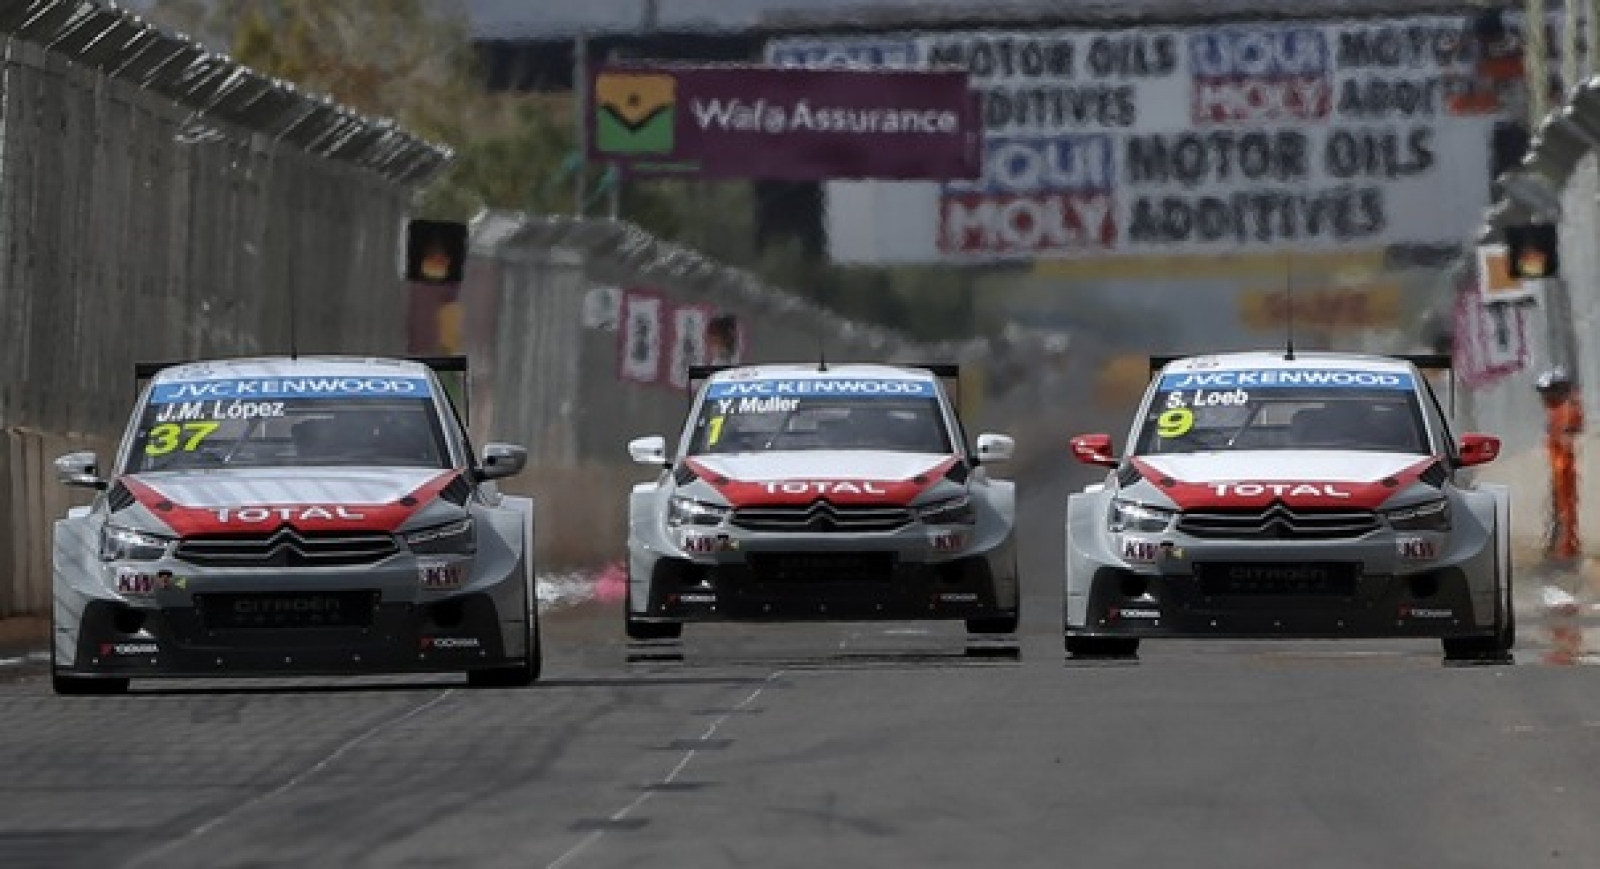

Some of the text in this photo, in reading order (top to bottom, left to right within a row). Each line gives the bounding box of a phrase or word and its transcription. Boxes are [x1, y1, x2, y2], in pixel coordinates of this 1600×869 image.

[1087, 35, 1174, 76] OILS
[789, 98, 958, 133] Assurance
[1128, 127, 1435, 185] MOTOR OILS
[946, 196, 1113, 250] MOLY
[1129, 185, 1385, 243] ADDITIVES
[157, 399, 284, 421] J.M. López
[718, 396, 801, 414] Y. Muller
[1168, 388, 1249, 408] S. Loeb
[709, 416, 724, 445] 1
[1157, 407, 1195, 437] 9
[145, 421, 220, 455] 37
[759, 480, 886, 494] TOTAL
[1208, 480, 1351, 497] TOTAL
[209, 505, 364, 523] TOTAL
